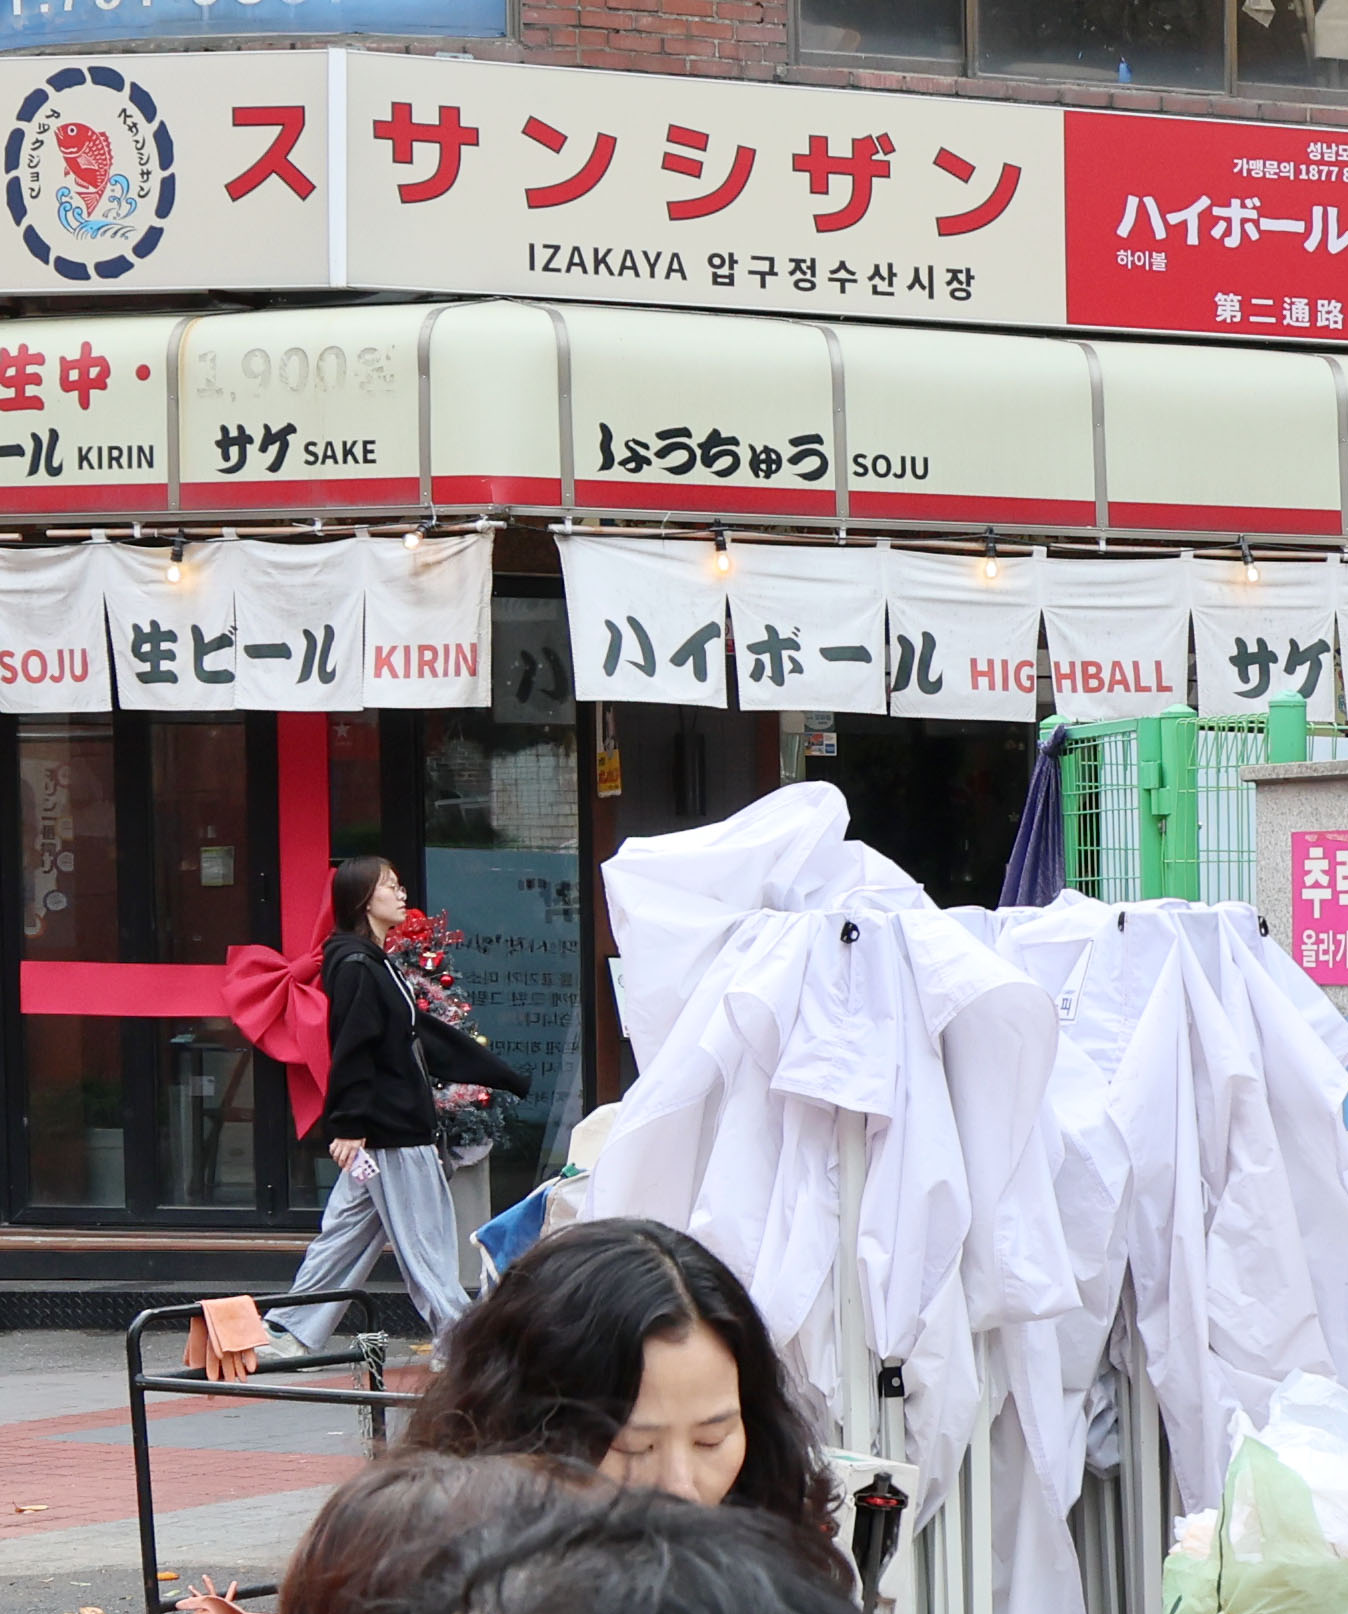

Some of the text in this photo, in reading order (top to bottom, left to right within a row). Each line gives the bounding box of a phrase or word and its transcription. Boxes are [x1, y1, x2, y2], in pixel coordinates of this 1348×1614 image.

[224, 101, 1022, 238] スサンシザン
[1232, 157, 1296, 181] 가맹문의
[1298, 164, 1339, 183] 1877
[527, 242, 976, 302] IZAKAYA 압구정수산시장
[1115, 248, 1168, 273] 하이볼
[1213, 291, 1345, 331] 第二通路
[77, 444, 155, 471] KIRIN
[214, 421, 378, 475] サケ SAKE
[597, 422, 930, 483] しょうちゅう SOJU
[0, 647, 90, 685] SOJU
[130, 618, 479, 685] 生ビール KIRIN
[602, 614, 1175, 697] ハイボール HIGHBALL
[1227, 636, 1332, 700] サケ
